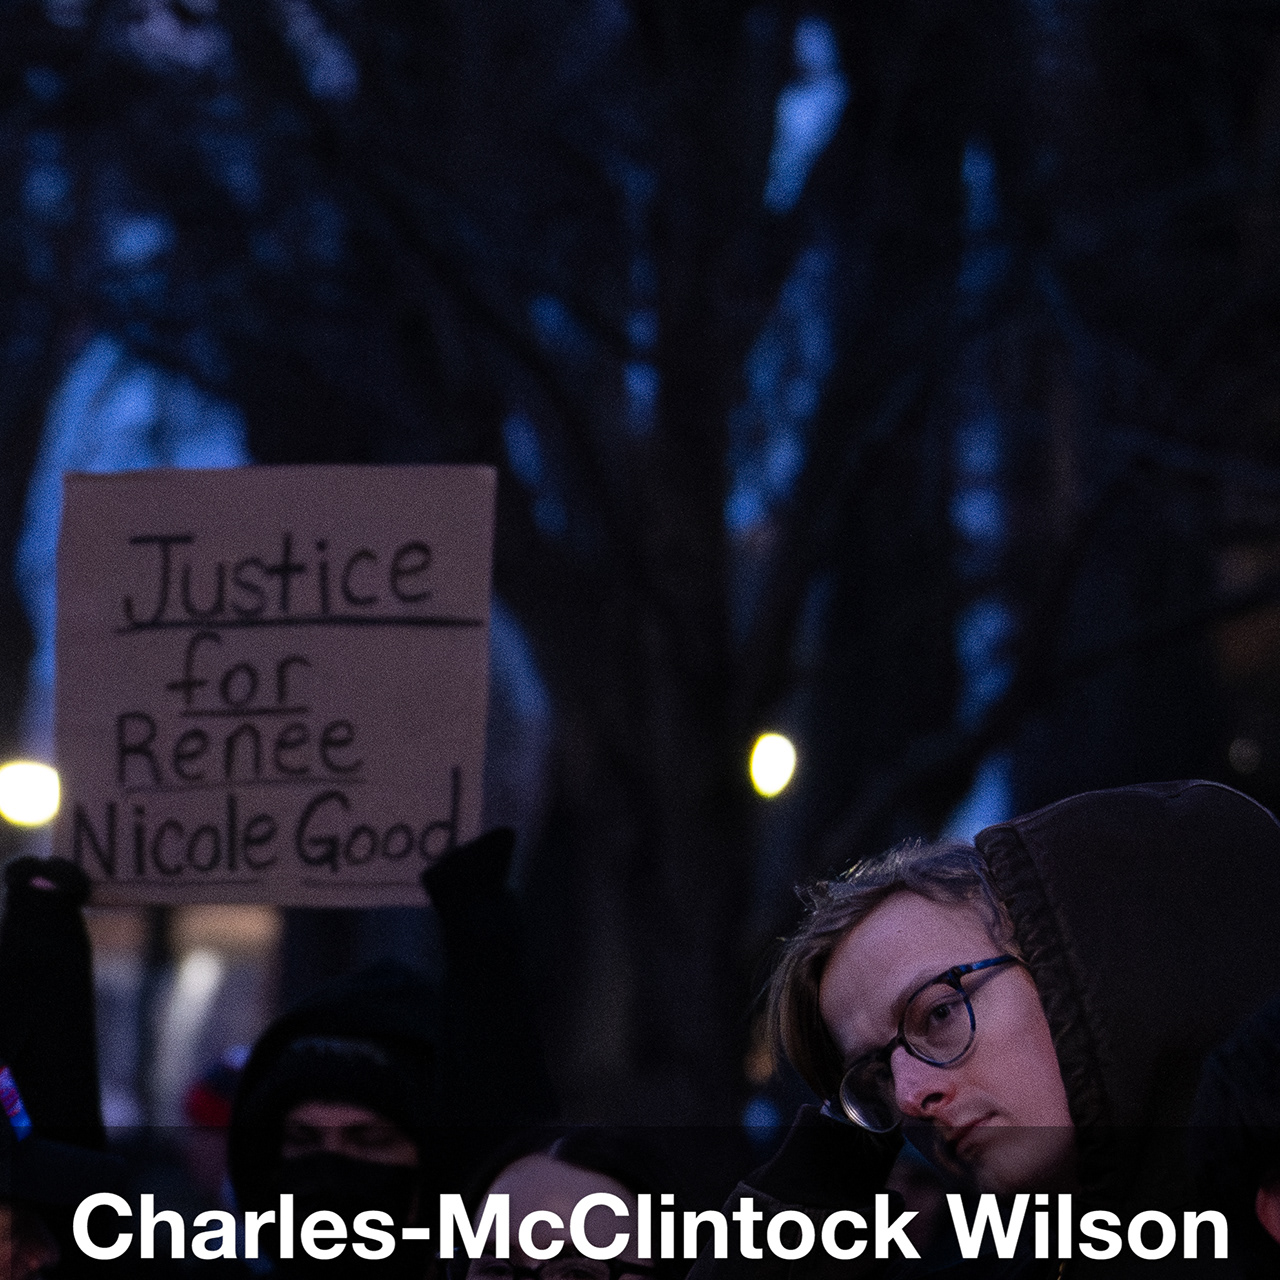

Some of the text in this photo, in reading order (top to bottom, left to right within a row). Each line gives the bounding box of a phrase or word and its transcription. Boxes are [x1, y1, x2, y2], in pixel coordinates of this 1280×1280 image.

[123, 533, 434, 627] Justice
[166, 631, 312, 706] for
[117, 711, 365, 785] Renee
[74, 766, 462, 879] Nicole Good
